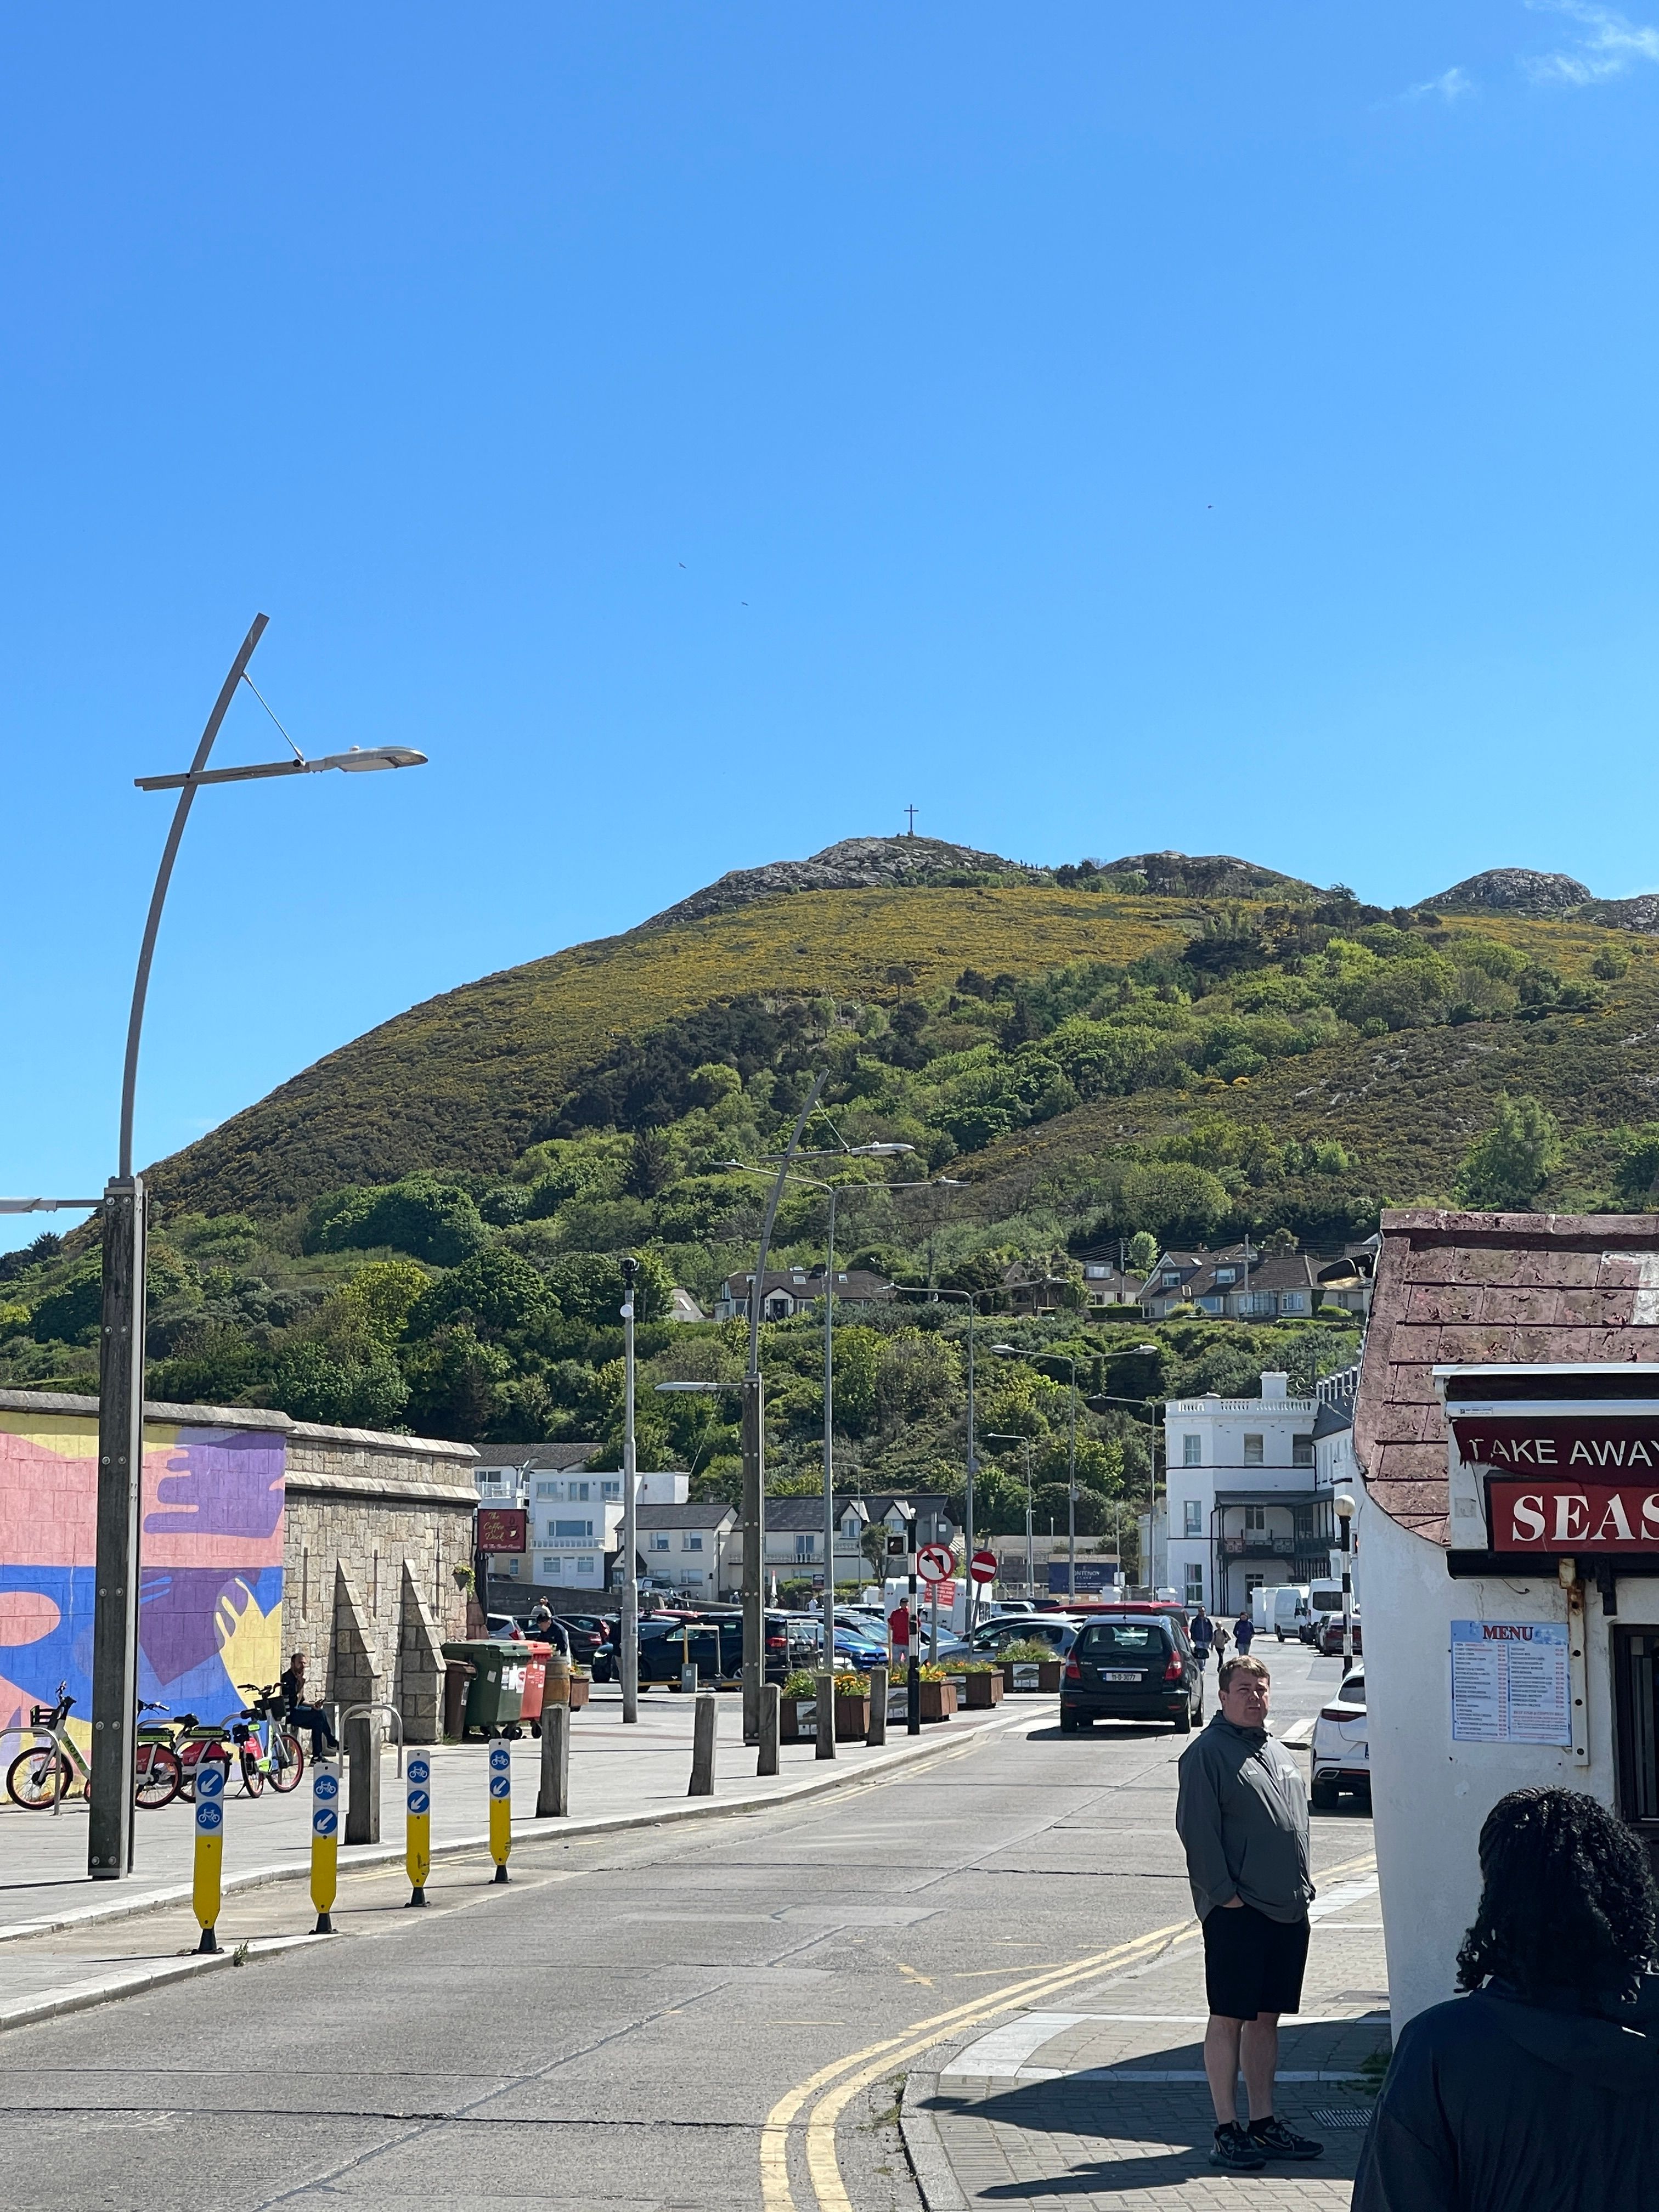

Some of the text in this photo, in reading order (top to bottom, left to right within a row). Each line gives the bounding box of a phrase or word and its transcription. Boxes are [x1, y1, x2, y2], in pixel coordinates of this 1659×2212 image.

[1467, 1438, 1558, 1464] TAKE
[488, 1511, 500, 1520] The
[483, 1522, 505, 1533] Coffee
[1482, 1625, 1534, 1641] MENU
[65, 1740, 82, 1764] MOBY
